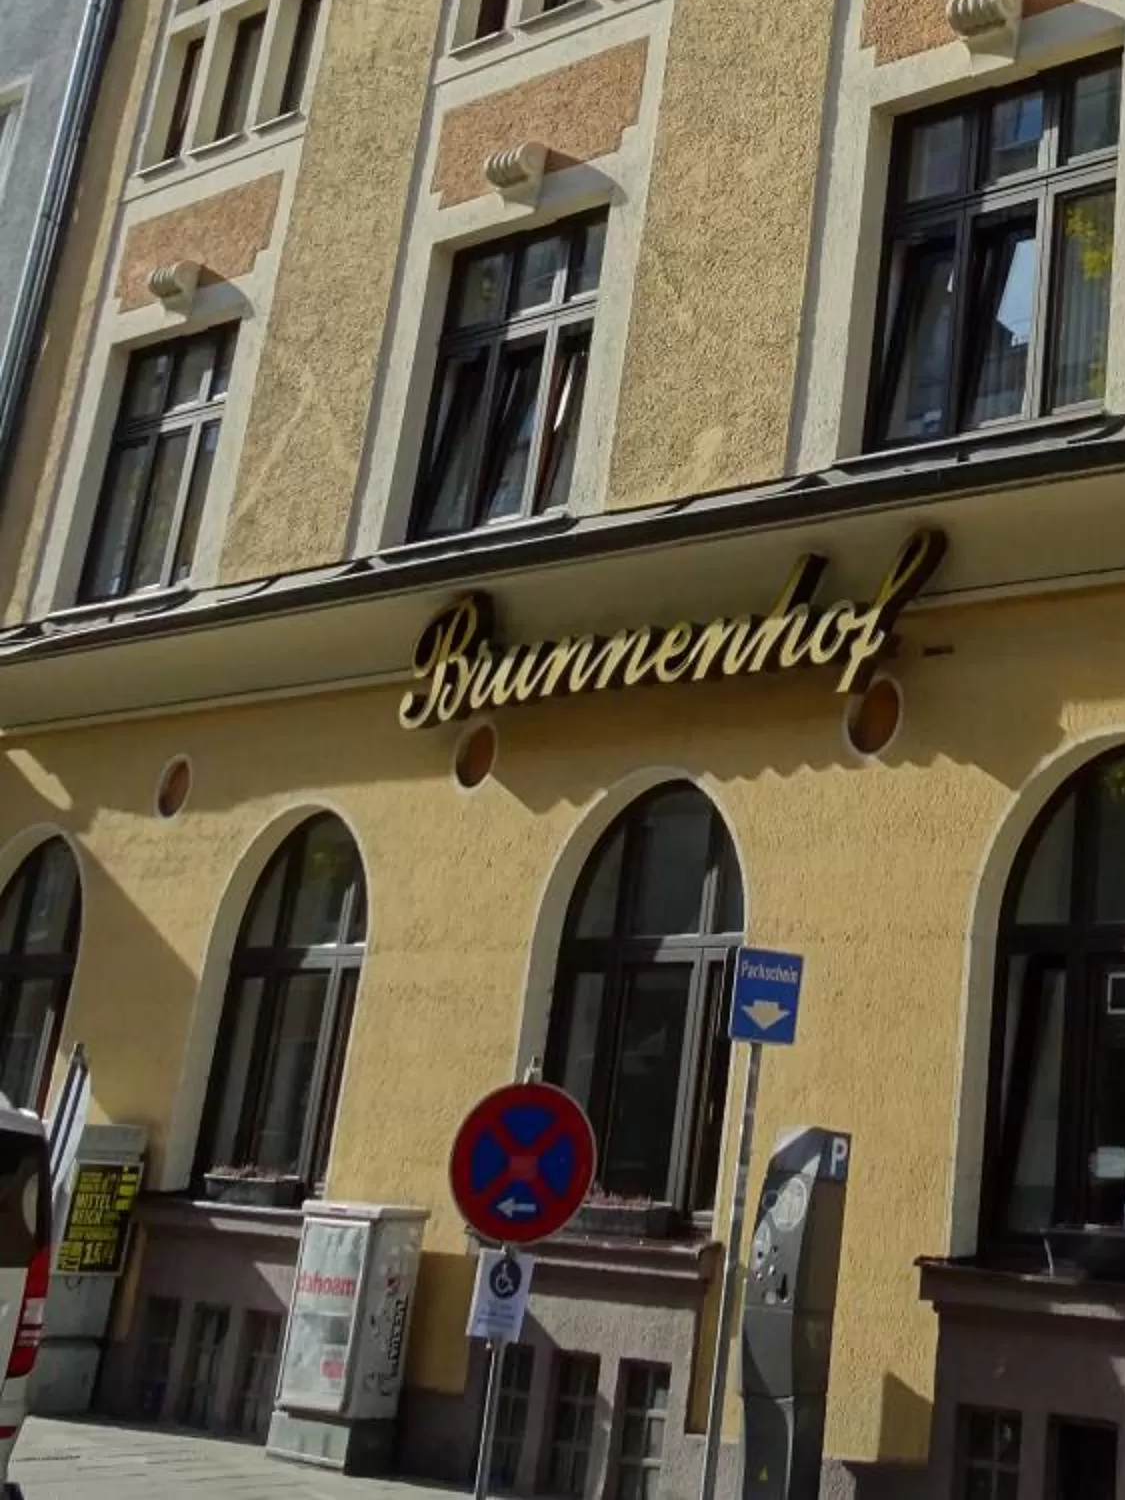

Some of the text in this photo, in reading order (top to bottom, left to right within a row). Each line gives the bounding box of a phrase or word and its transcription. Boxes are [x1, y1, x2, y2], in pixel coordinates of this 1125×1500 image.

[400, 528, 936, 729] Brunnenhof
[740, 959, 799, 985] Parkschein
[830, 1136, 850, 1177] P
